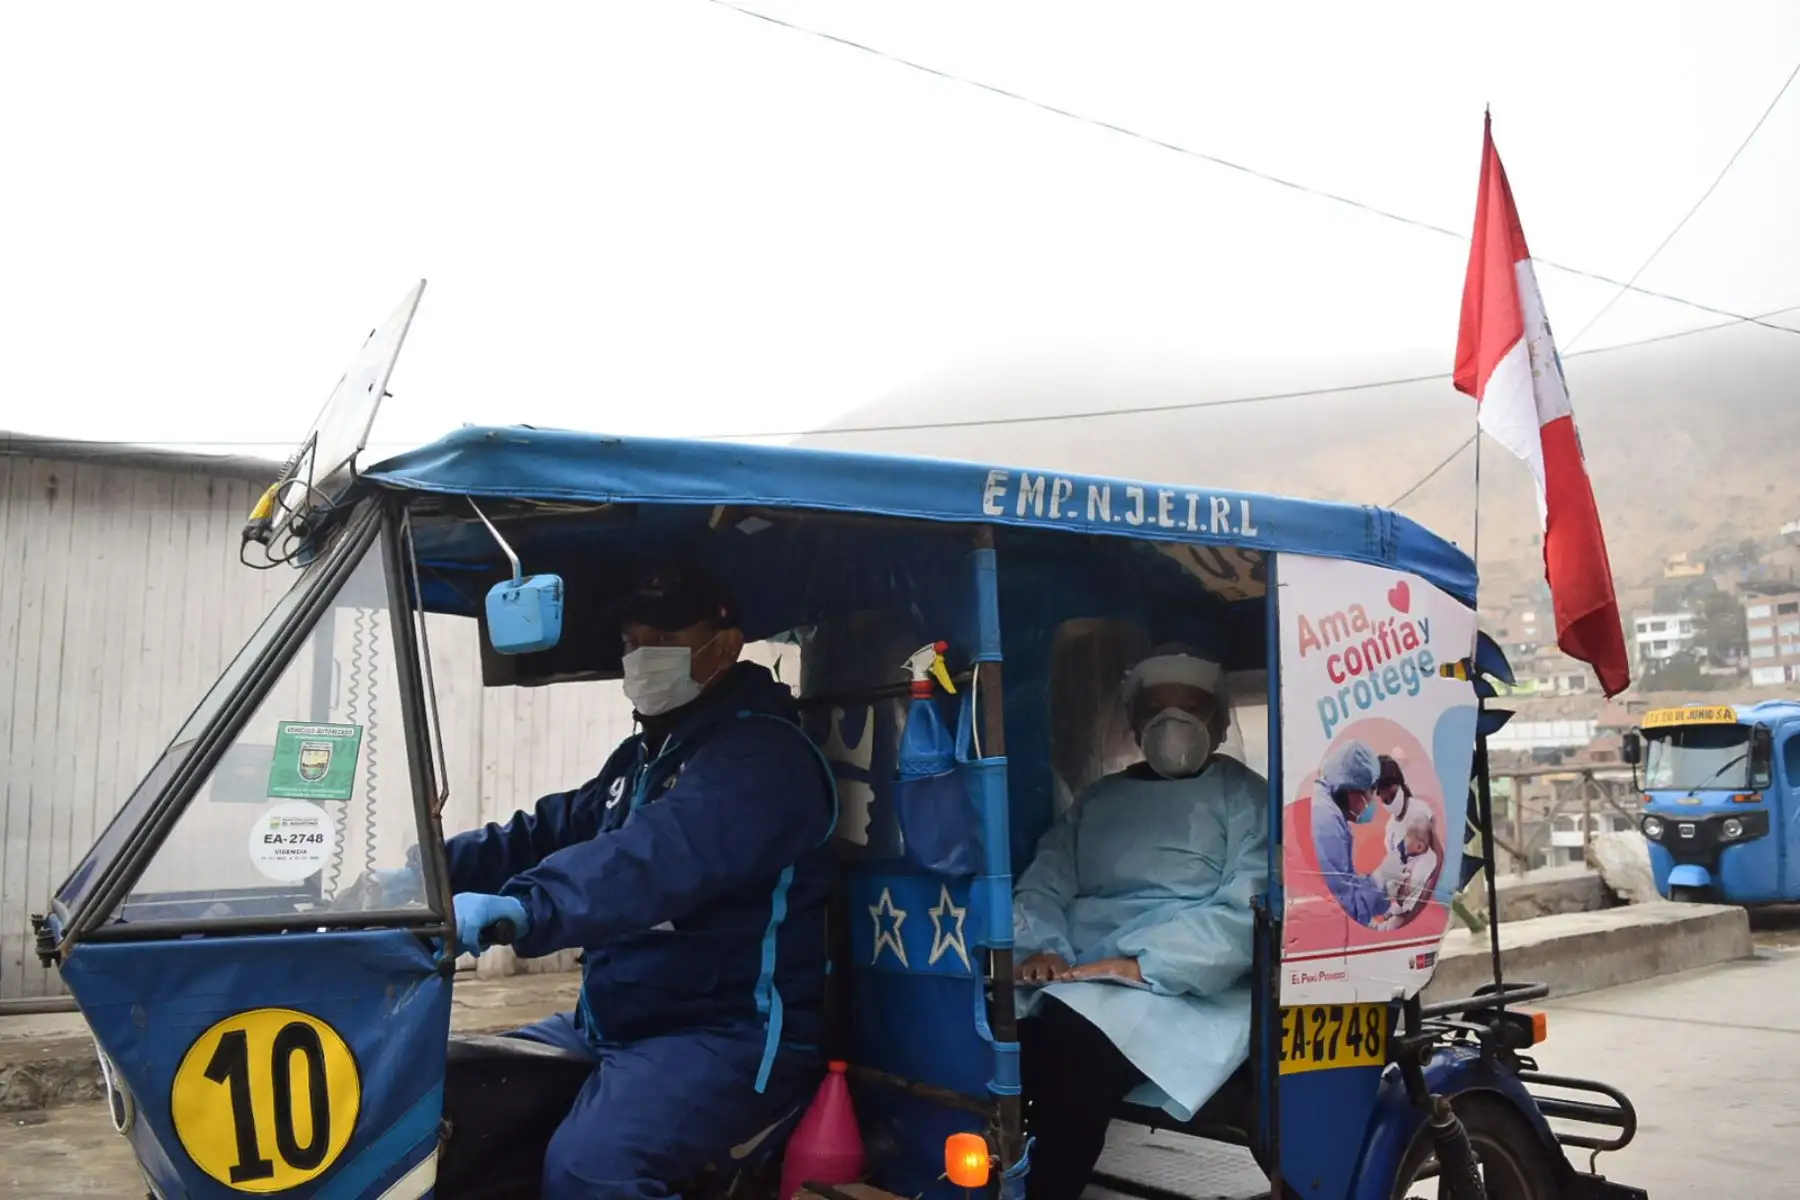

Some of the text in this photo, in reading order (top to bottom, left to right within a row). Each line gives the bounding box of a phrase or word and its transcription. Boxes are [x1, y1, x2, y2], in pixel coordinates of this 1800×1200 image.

[1296, 603, 1377, 657] Ama,
[1327, 616, 1430, 684] confía y
[1316, 649, 1436, 739] protege
[606, 776, 626, 809] 9
[263, 833, 324, 844] EA-2748
[1279, 1006, 1381, 1062] EA-2748
[203, 1020, 331, 1184] 10
